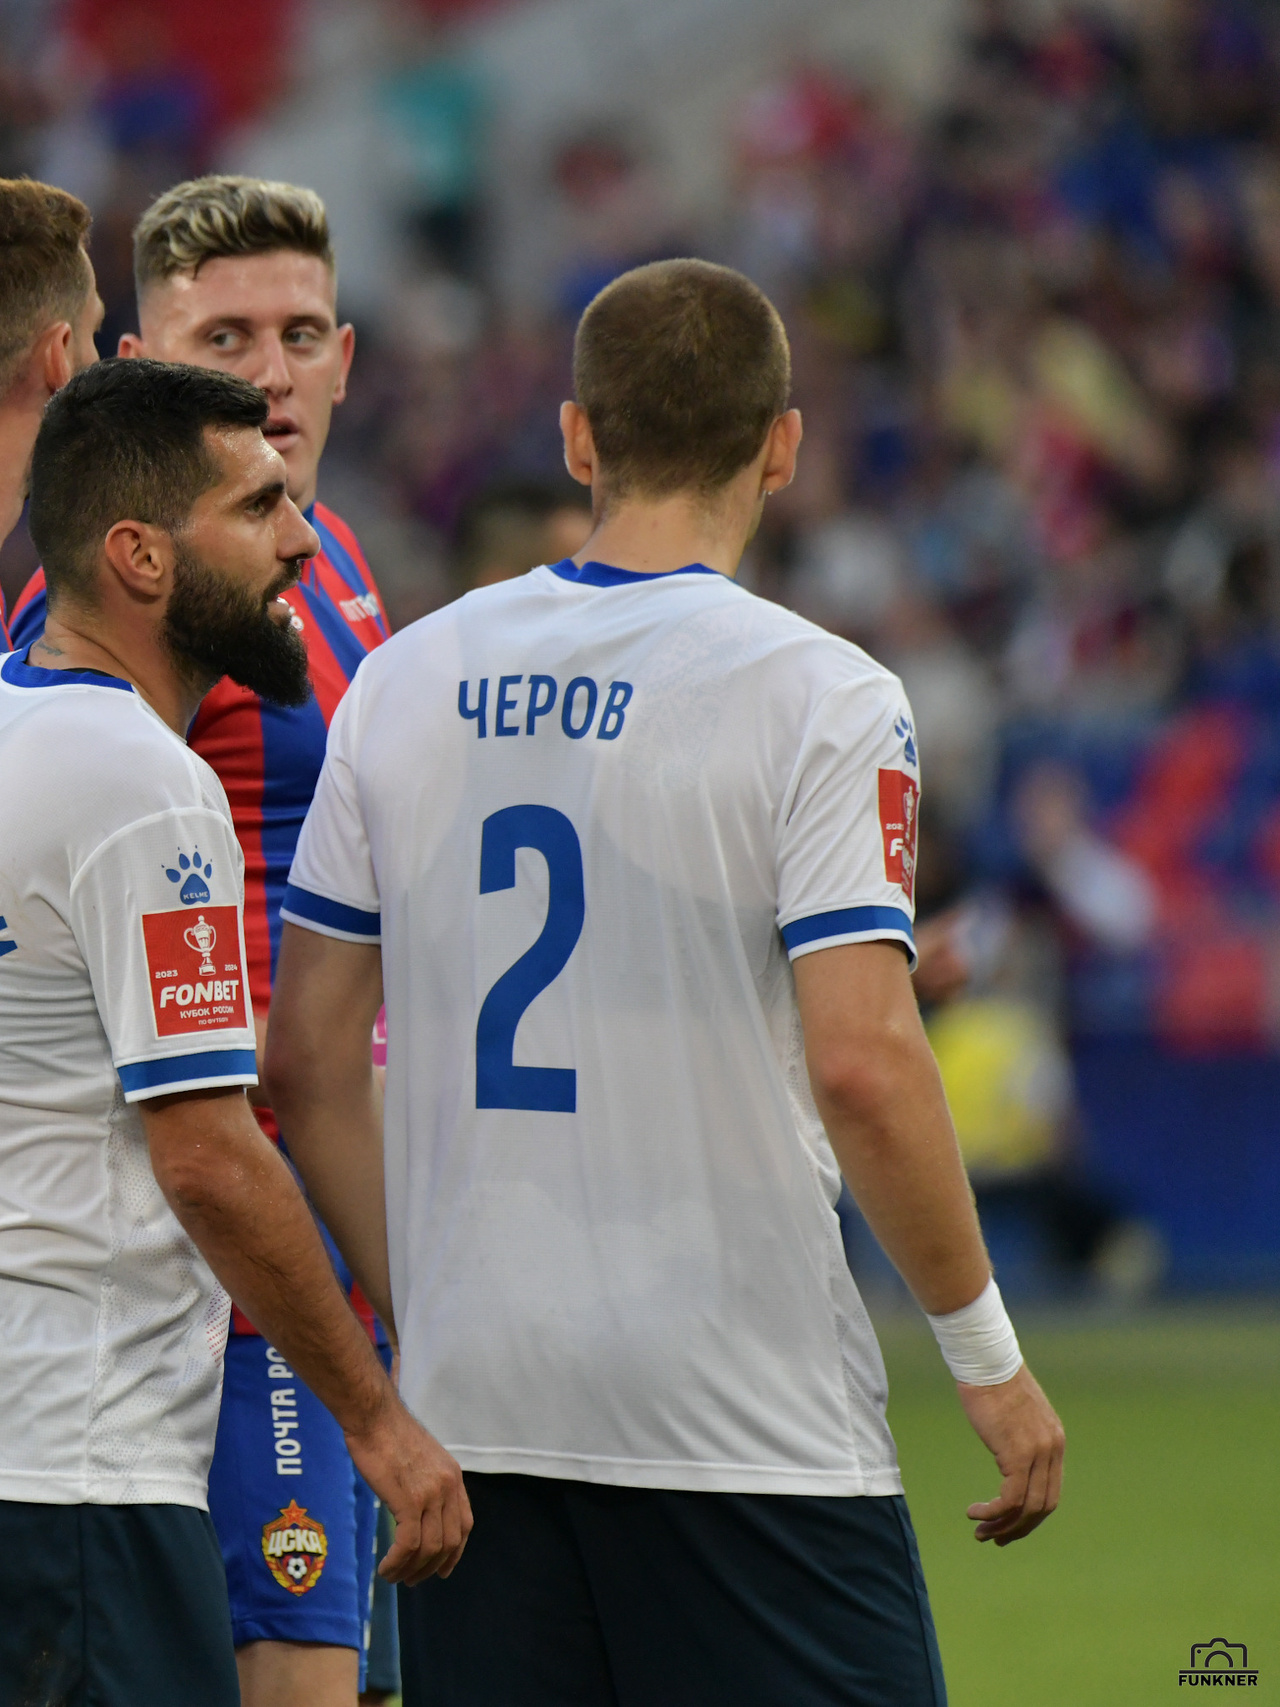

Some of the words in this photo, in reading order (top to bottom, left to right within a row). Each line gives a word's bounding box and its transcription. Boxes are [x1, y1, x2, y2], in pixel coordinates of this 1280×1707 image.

[457, 674, 634, 741] ЧЕРОВ
[182, 891, 209, 900] KELME
[475, 803, 585, 1114] 2
[155, 969, 179, 979] 2023
[159, 979, 240, 1009] FONBET
[179, 1008, 211, 1019] КУБОК
[270, 1387, 303, 1476] ПОЧТА
[267, 1528, 324, 1558] ЦСКА
